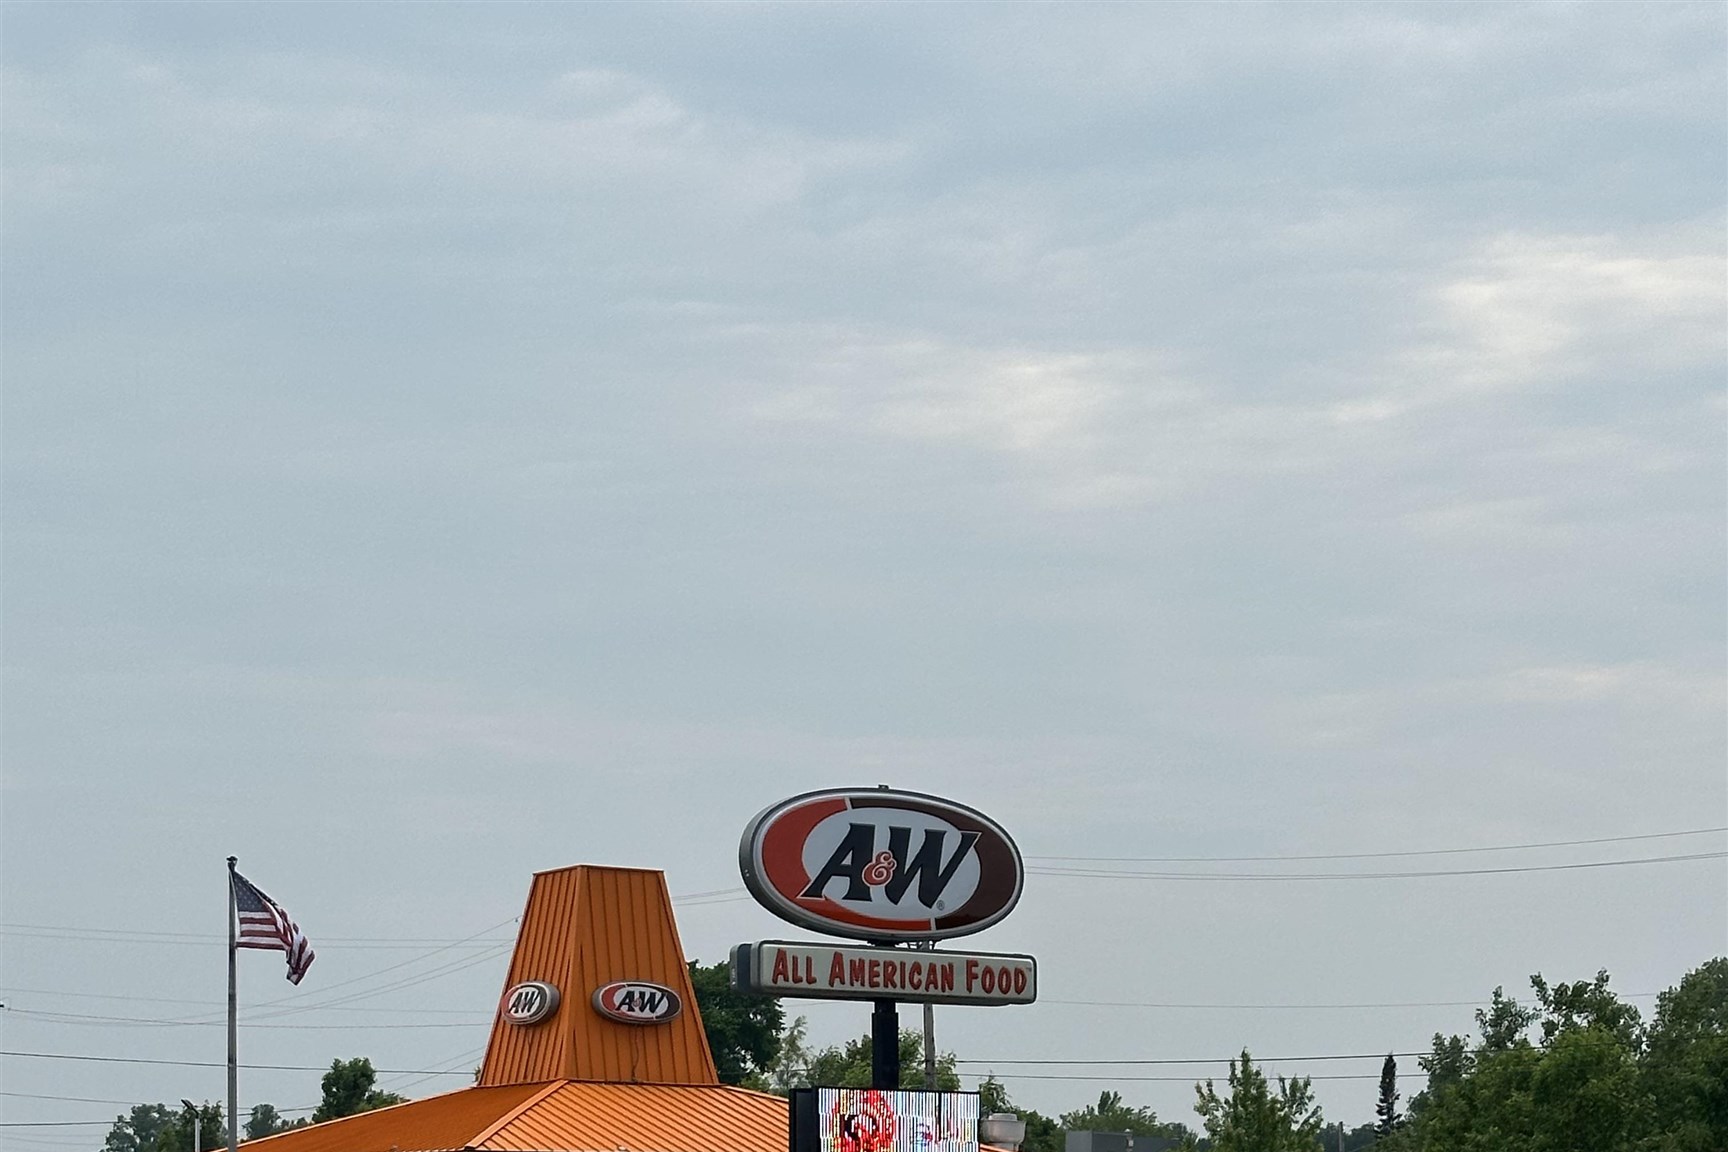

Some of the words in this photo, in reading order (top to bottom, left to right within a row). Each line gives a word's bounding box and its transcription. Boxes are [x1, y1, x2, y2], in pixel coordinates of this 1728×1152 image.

[796, 822, 982, 909] A&W
[771, 948, 817, 985] ALL
[828, 951, 954, 993] AMERICAN
[965, 959, 1028, 995] FOOD
[508, 991, 540, 1014] A&W
[615, 990, 665, 1014] A&W
